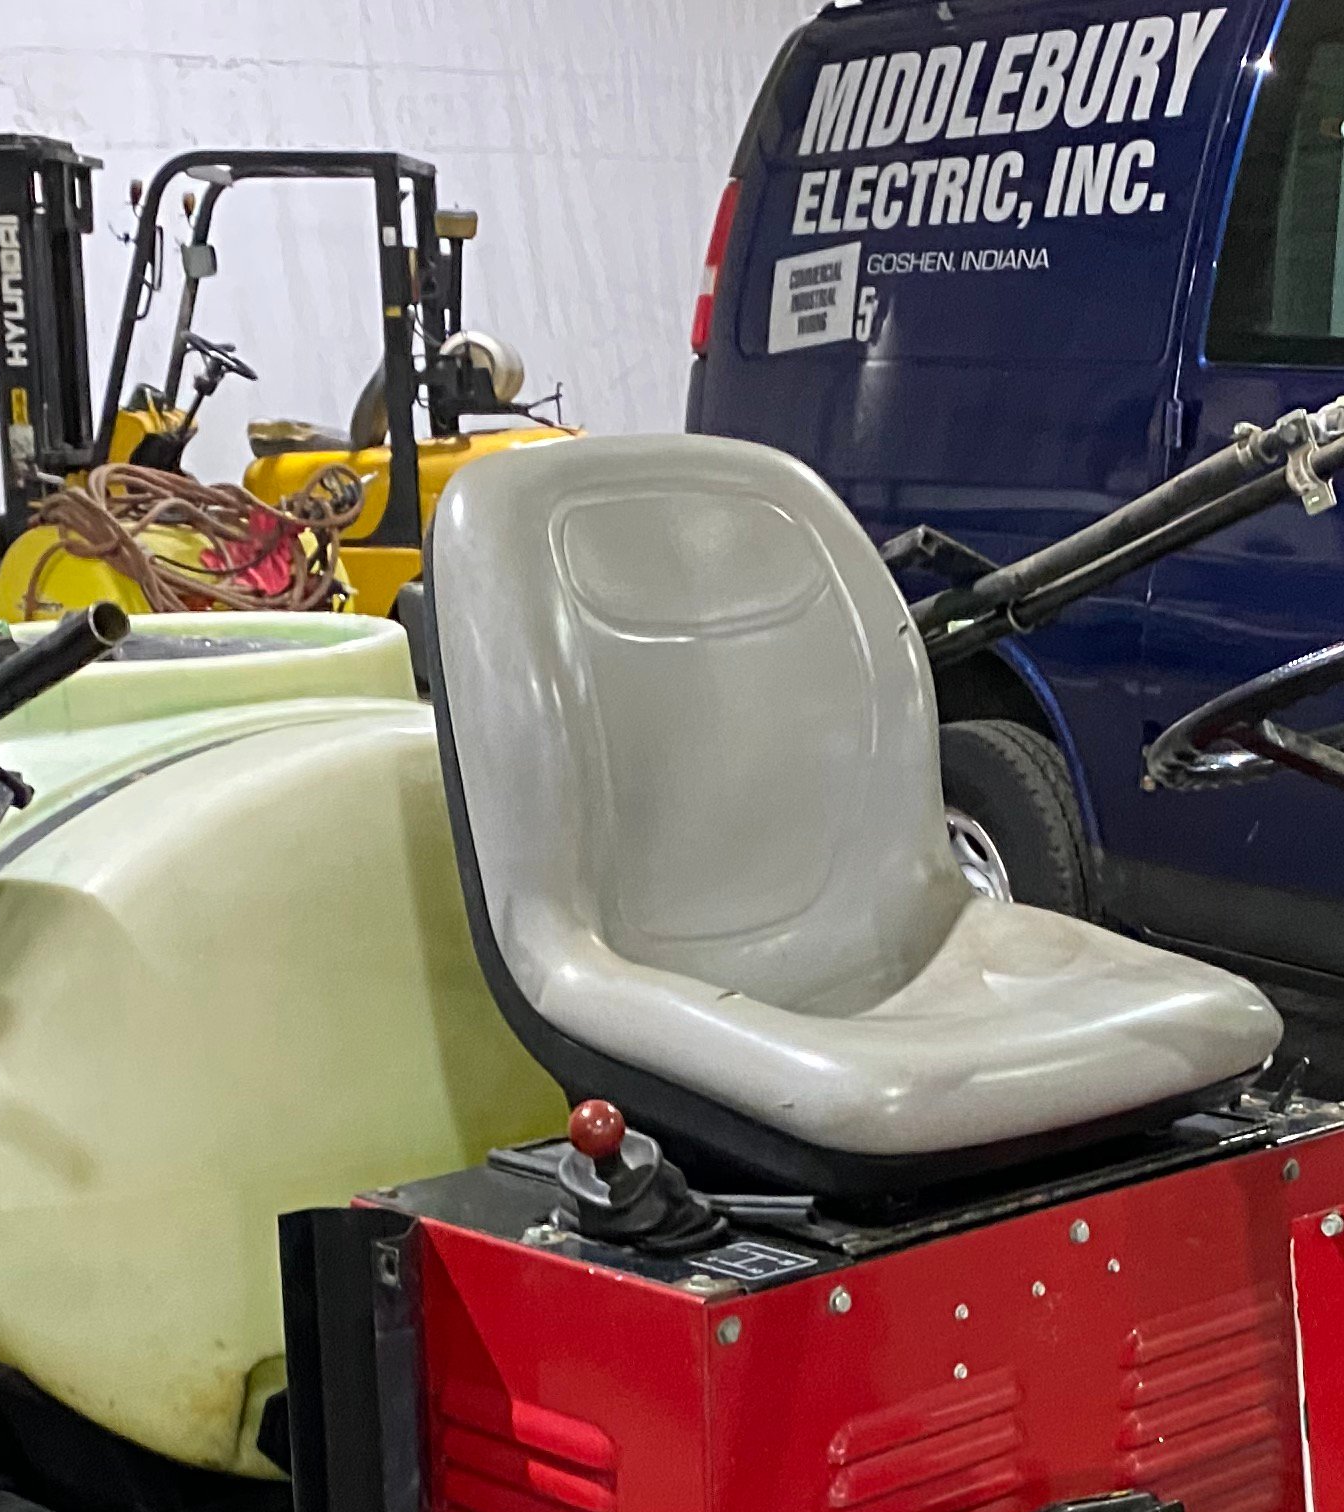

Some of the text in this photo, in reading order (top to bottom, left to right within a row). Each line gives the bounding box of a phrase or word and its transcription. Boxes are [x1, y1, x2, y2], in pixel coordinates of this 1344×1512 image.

[798, 8, 1227, 156] MIDDLEBURY
[792, 139, 1166, 235] ELECTRIC, INC.
[961, 248, 1049, 271] INDIANA
